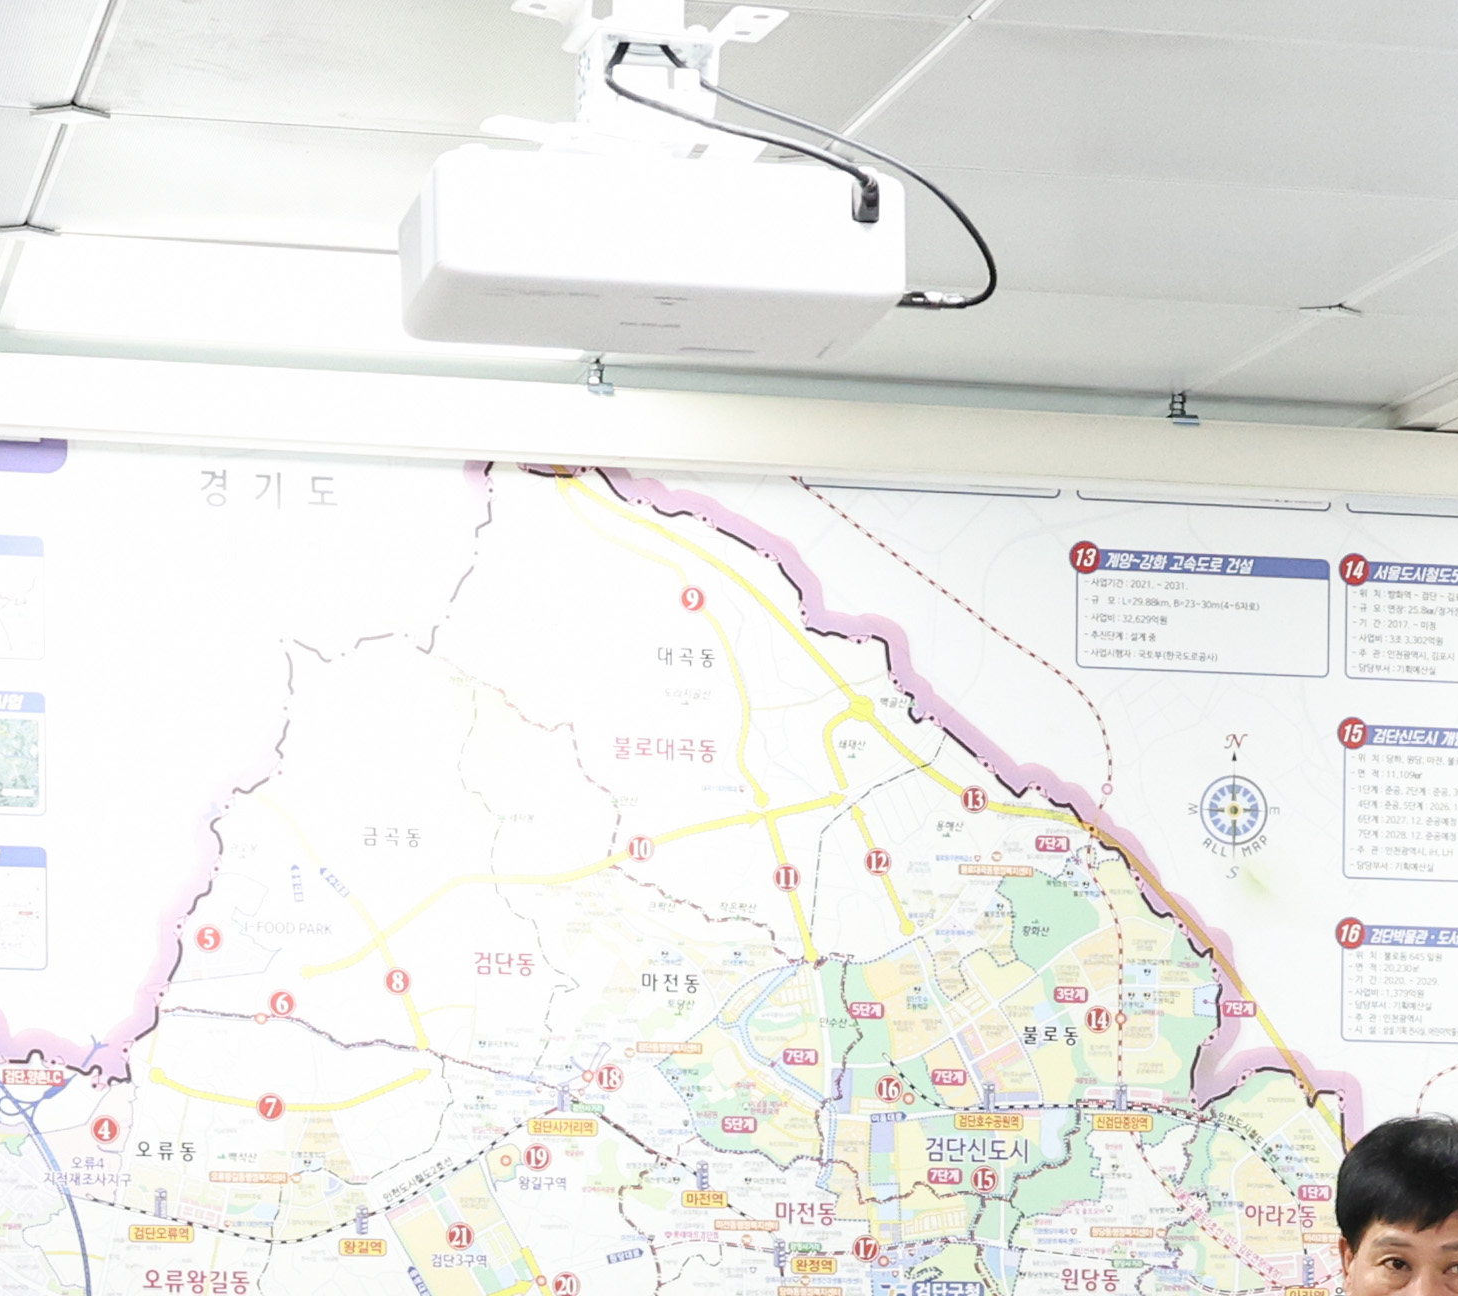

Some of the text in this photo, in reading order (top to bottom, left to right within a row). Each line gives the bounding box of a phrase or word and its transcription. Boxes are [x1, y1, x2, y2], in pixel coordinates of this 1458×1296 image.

[200, 469, 338, 510] 경기도
[1075, 548, 1097, 567] 13
[1105, 552, 1255, 574] 계양~강화 고속도로 건설
[1344, 562, 1366, 579] 14
[658, 647, 715, 668] 대곡동
[1343, 724, 1365, 743] 15
[1372, 728, 1439, 746] 검단신도시
[613, 737, 717, 763] 불로대곡동
[364, 828, 421, 848] 금곡동
[299, 922, 332, 936] PARK
[1339, 925, 1361, 943] 16
[1370, 928, 1429, 947] 검단박물관
[474, 952, 535, 976] 검단동
[642, 973, 699, 994] 마전동
[1023, 1026, 1079, 1046] 불로동
[532, 1121, 593, 1134] 검단사거리역
[136, 1141, 196, 1161] 오류동
[926, 1138, 1028, 1164] 검단신도시
[44, 1172, 131, 1186] 지적재조사지구
[686, 1193, 723, 1206] 마전역
[775, 1202, 836, 1226] 마전동
[1245, 1205, 1316, 1229] 아라2동
[134, 1227, 189, 1240] 검단오류역
[344, 1241, 382, 1254] 왕길역
[431, 1253, 487, 1268] 검단3구역
[796, 1260, 832, 1272] 완정역
[143, 1269, 250, 1295] 오류왕길동
[1062, 1268, 1121, 1292] 원당동
